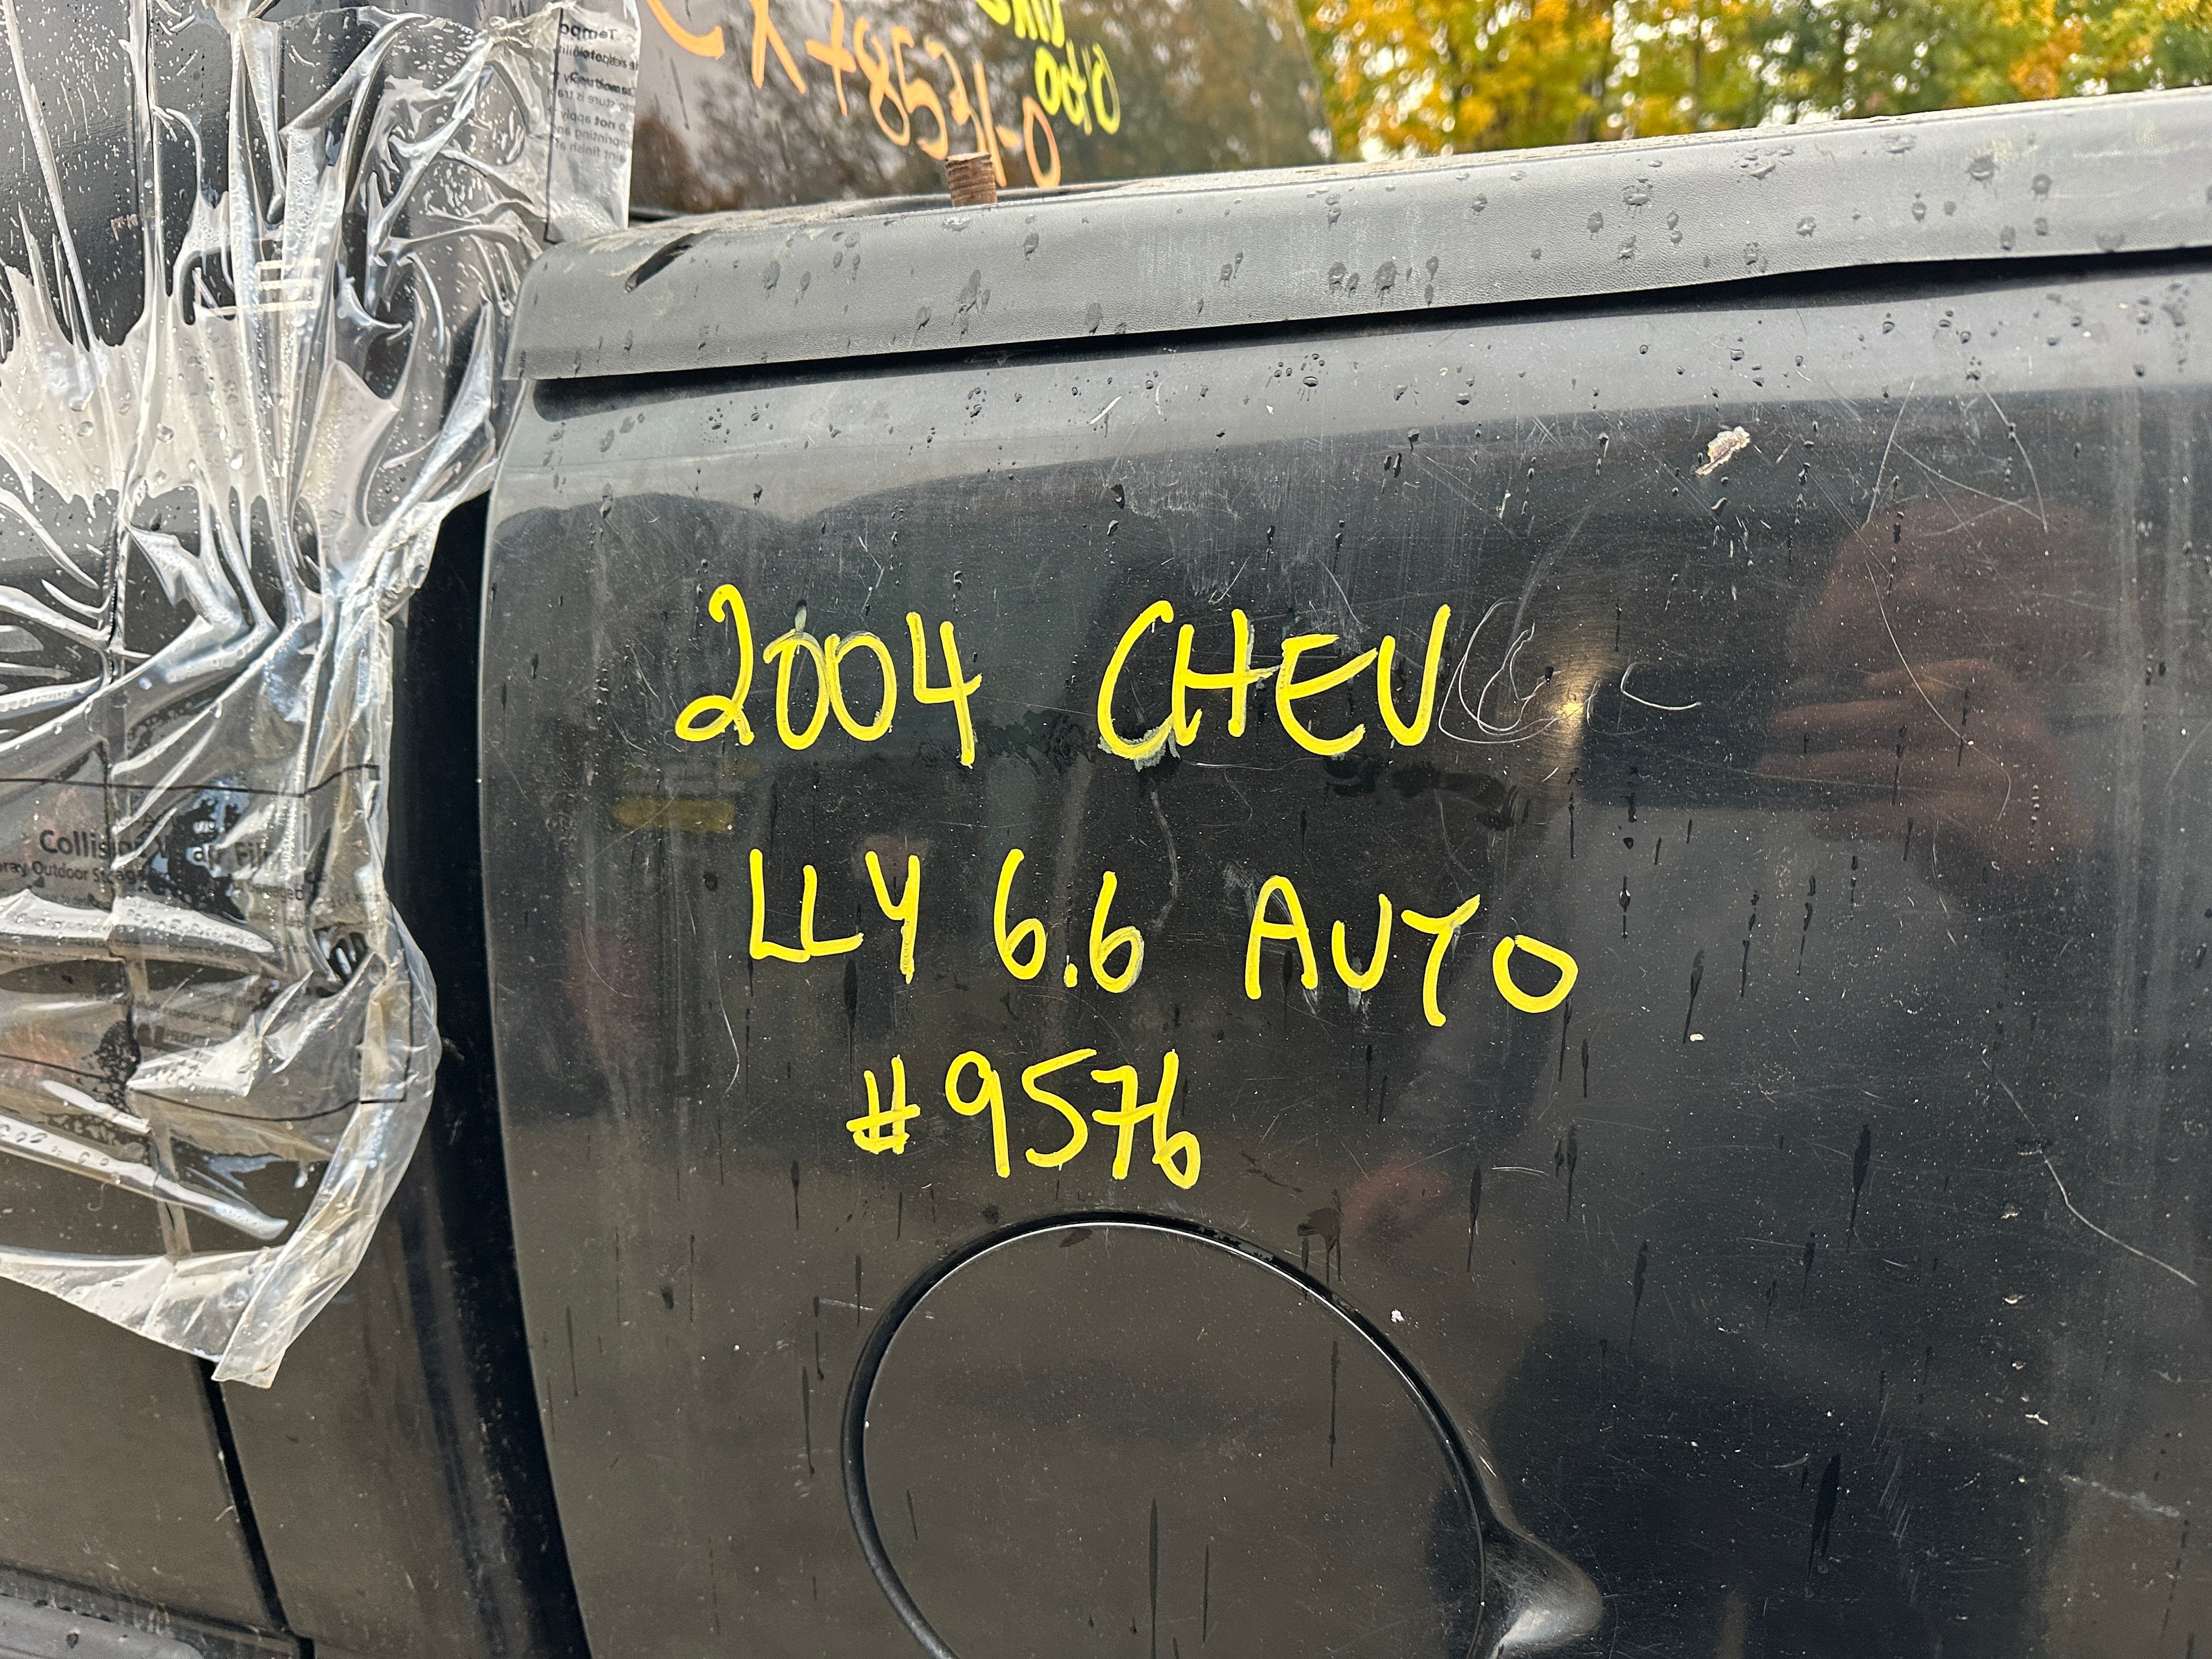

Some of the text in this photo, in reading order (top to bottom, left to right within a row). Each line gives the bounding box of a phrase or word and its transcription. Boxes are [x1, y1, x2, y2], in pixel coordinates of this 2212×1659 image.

[675, 584, 1451, 767] 2004 CHEV
[32, 861, 89, 881] Outdoor
[749, 848, 1578, 1027] LLY 6.6 AUTO
[846, 1048, 1202, 1189] #9576
